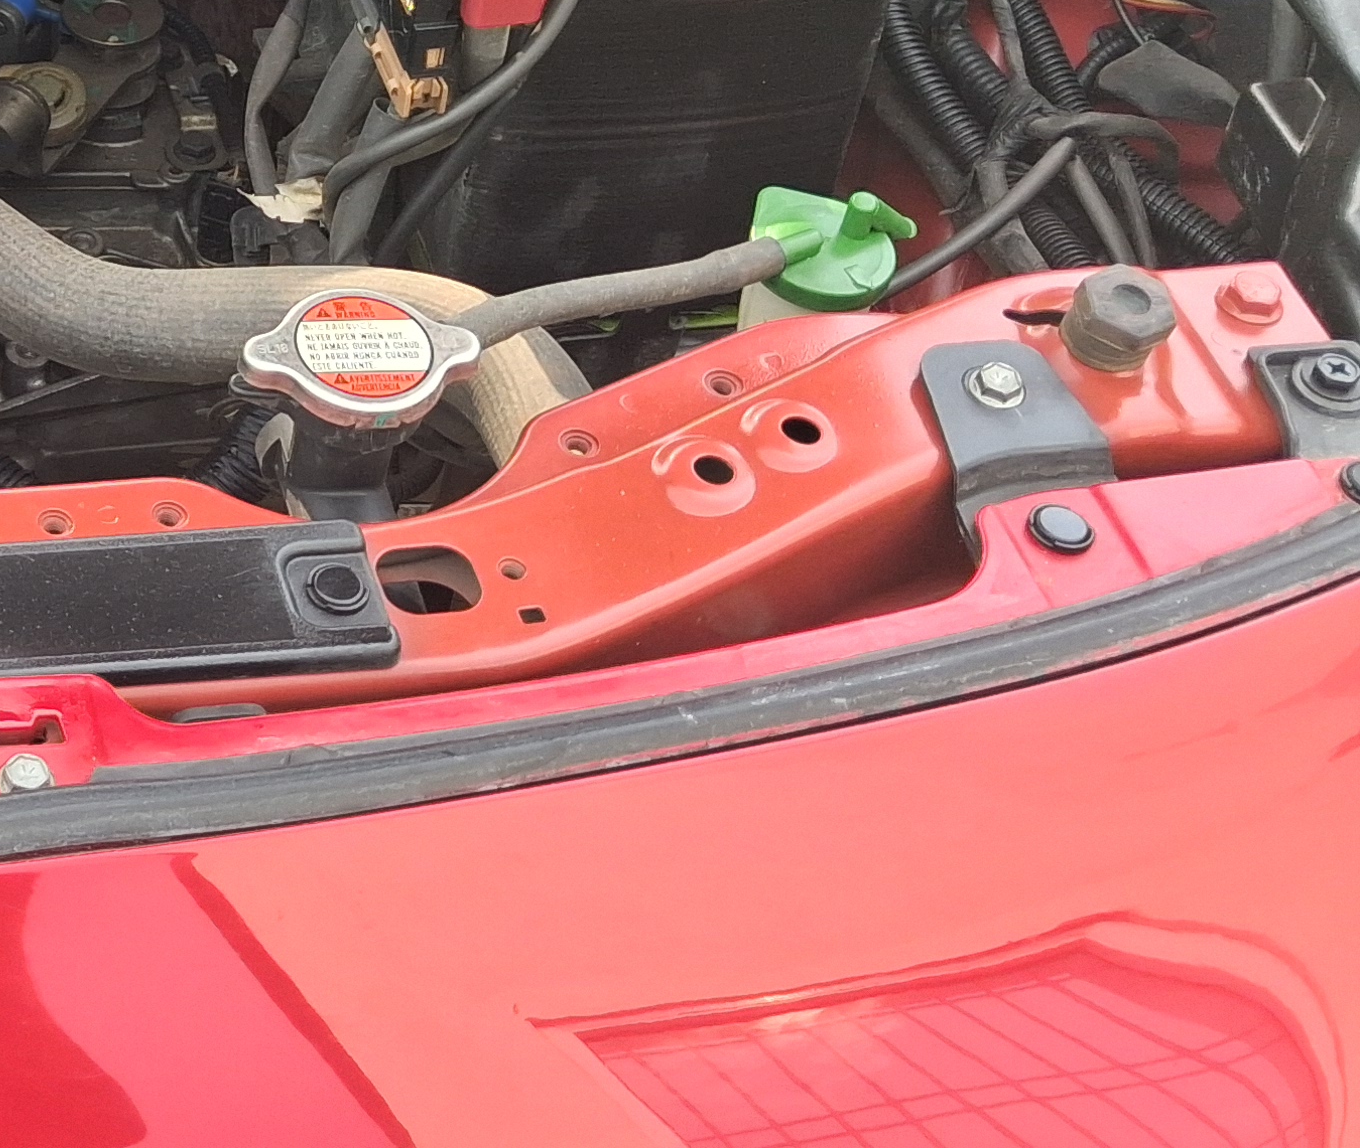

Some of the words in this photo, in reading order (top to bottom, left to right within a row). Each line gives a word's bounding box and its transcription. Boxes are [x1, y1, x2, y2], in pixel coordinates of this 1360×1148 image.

[335, 311, 376, 319] WARNING
[334, 333, 357, 341] OPEN
[361, 332, 384, 340] WHEN
